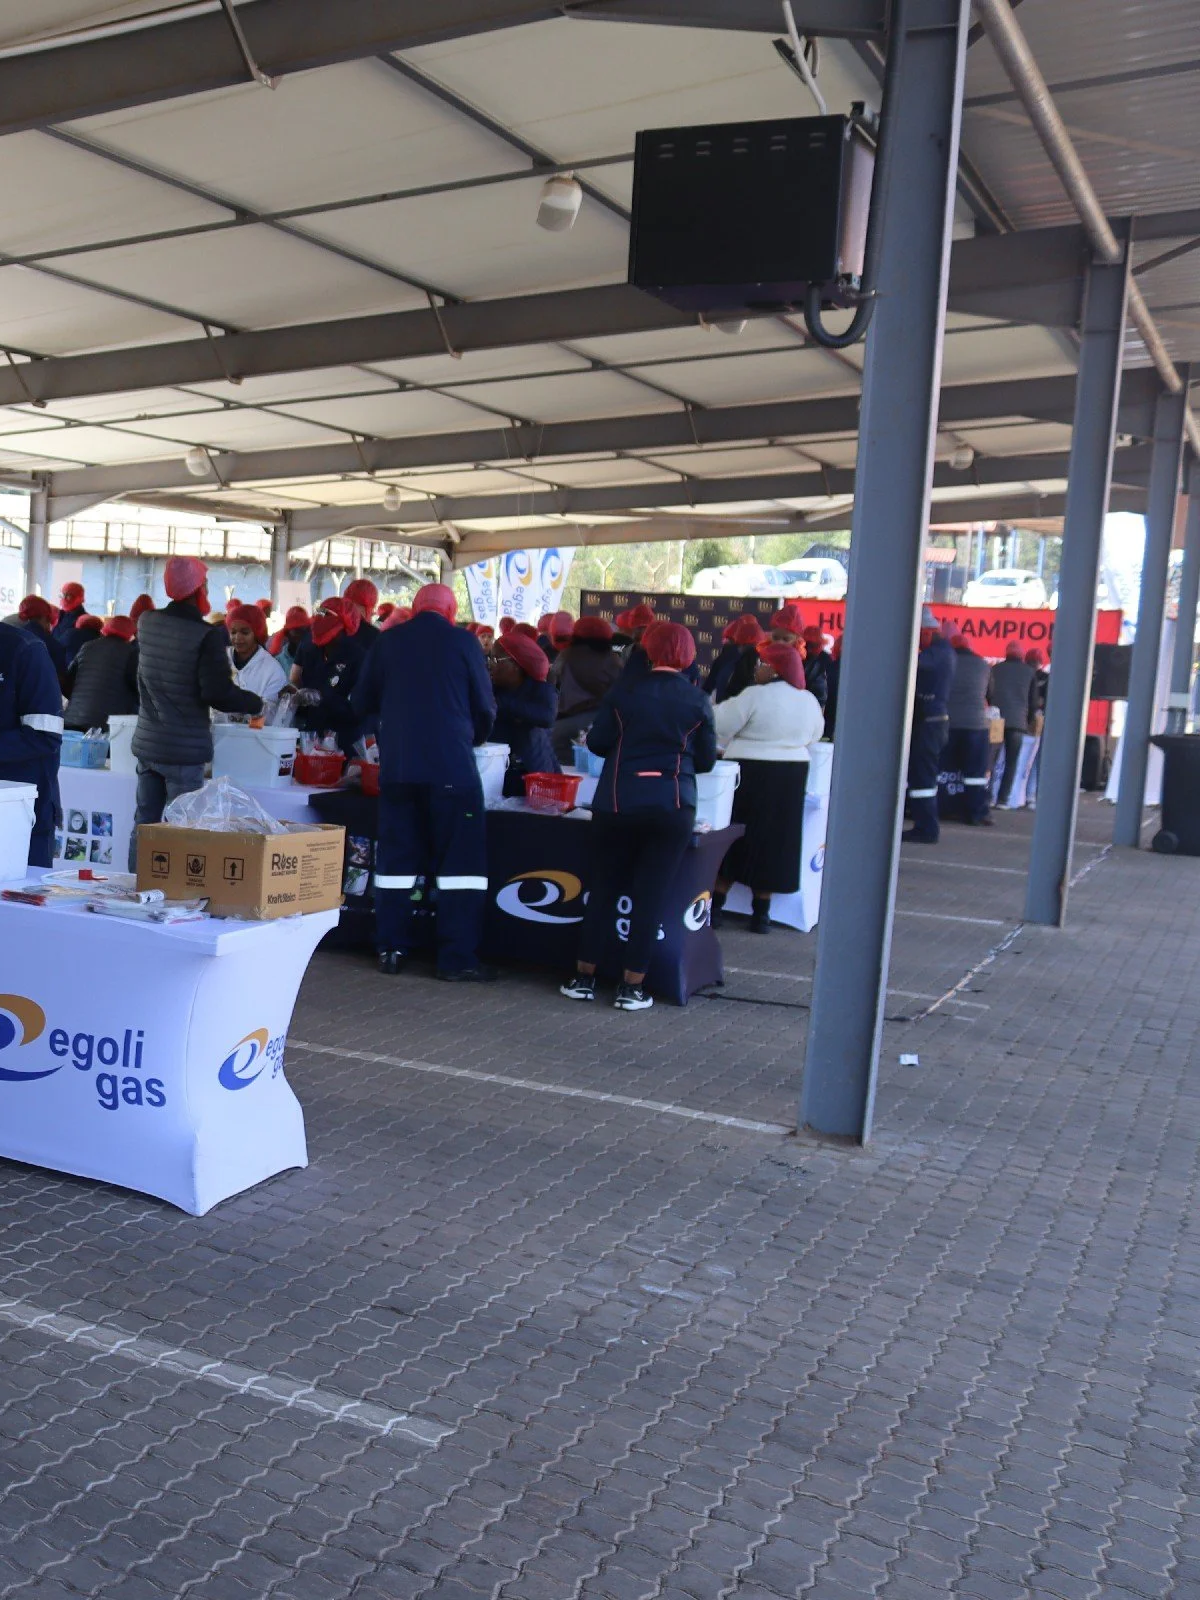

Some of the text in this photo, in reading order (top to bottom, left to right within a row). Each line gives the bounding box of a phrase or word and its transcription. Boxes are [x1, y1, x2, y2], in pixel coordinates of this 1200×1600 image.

[934, 617, 1053, 641] AMPIO
[49, 1028, 145, 1071] egoli
[266, 1034, 285, 1061] ego
[96, 1072, 167, 1111] gas
